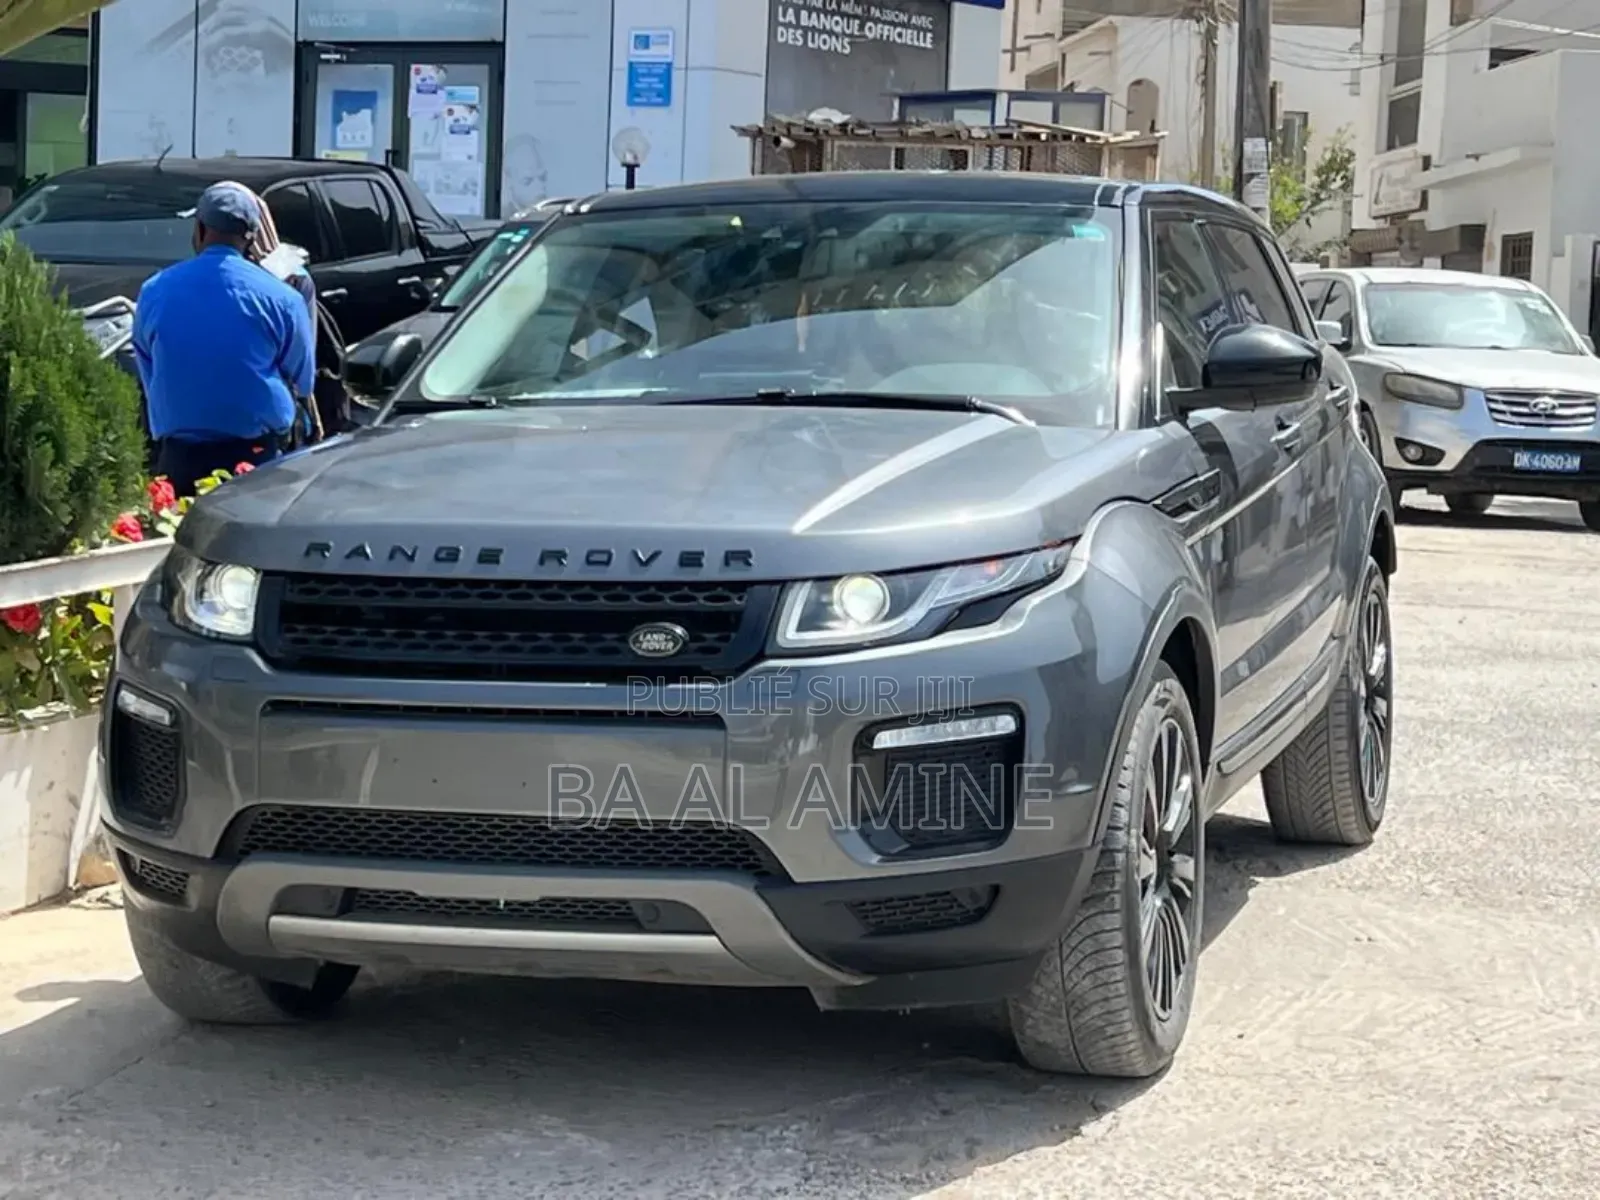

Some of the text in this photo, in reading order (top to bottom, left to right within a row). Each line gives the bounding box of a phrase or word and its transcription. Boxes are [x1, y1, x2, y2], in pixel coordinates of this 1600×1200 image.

[777, 5, 934, 49] LA BANQUE OFFICIELLE
[870, 6, 909, 24] PASSION
[910, 15, 934, 29] AVEC
[777, 26, 851, 55] DES LIONS
[304, 541, 757, 568] RANGE ROVER
